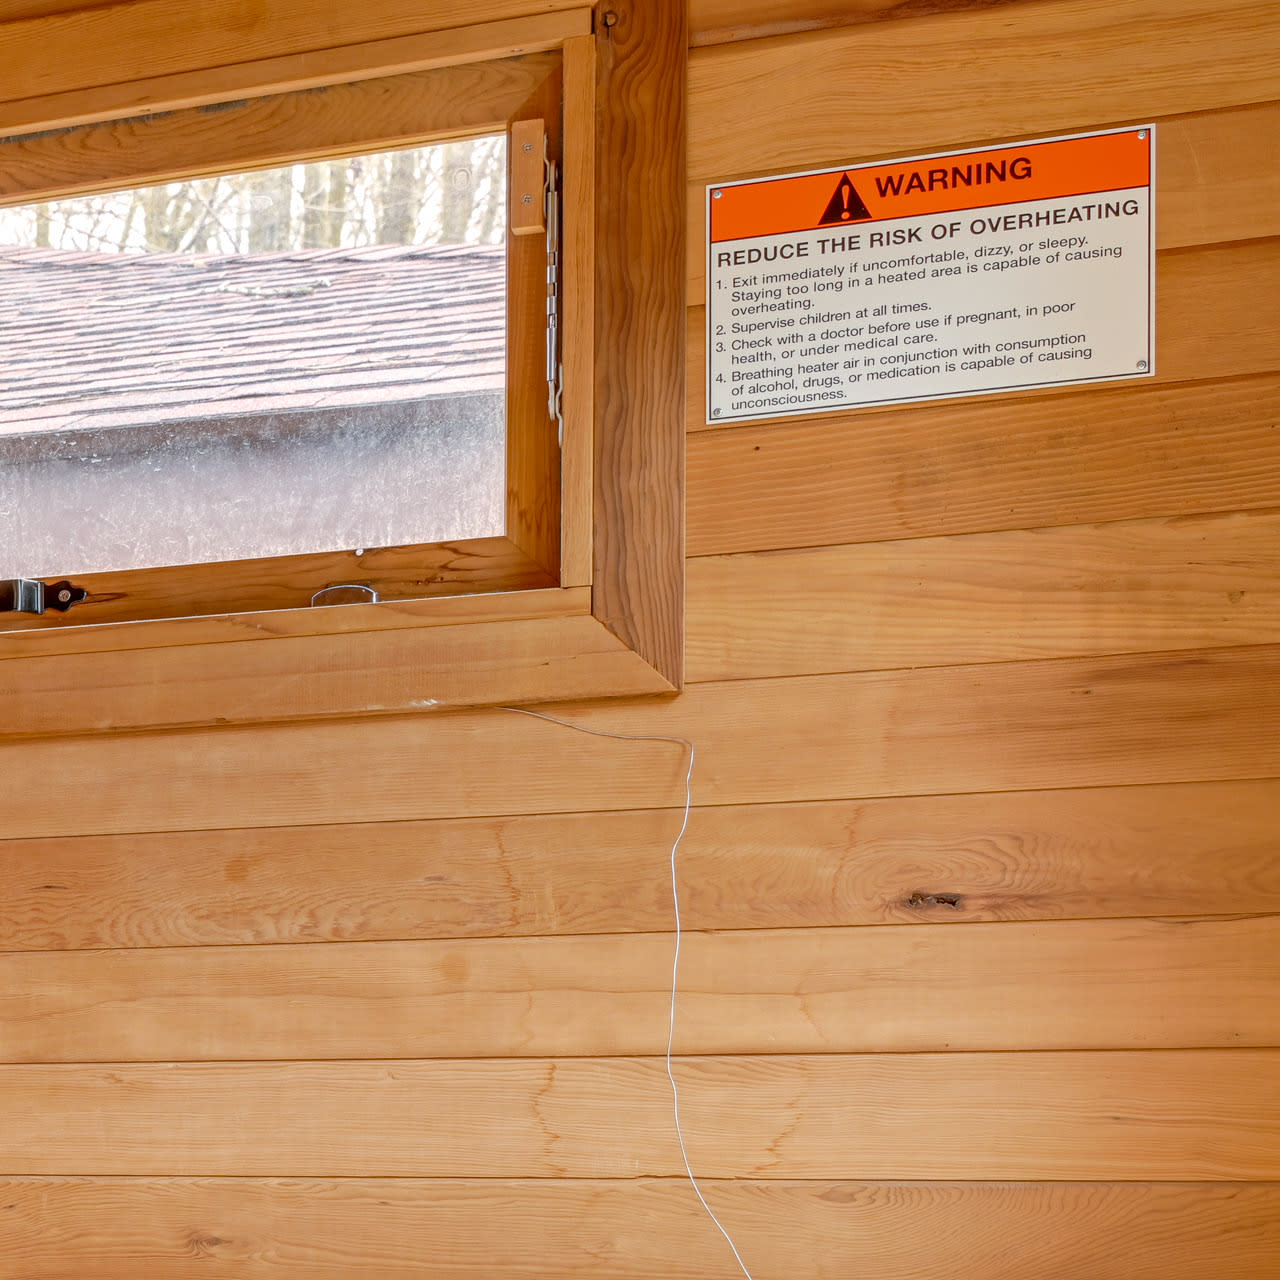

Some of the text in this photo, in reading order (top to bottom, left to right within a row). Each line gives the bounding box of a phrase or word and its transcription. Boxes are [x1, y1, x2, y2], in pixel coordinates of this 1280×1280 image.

[875, 157, 1032, 197] WARNING
[718, 200, 1138, 268] REDUCE THE RISK OF OVERHEATING
[716, 236, 1088, 290] 1. Exit immediately if uncomfortable, dizzy, or sleepy.
[731, 246, 1122, 302] Staying too long in a heated area is capable of causing
[716, 302, 932, 336] 2. Supervise children at all times.
[716, 302, 1076, 353] 3. Check with a doctor before use if pregnant, in poor
[732, 299, 815, 317] overheating.
[715, 333, 1086, 383] 4. Breathing heater air in conjunction with consumption
[732, 334, 937, 365] health, or under medical care.
[732, 347, 1092, 396] of alcohol, drugs, or medication is capable of causing
[732, 390, 847, 410] unconsciousness.
